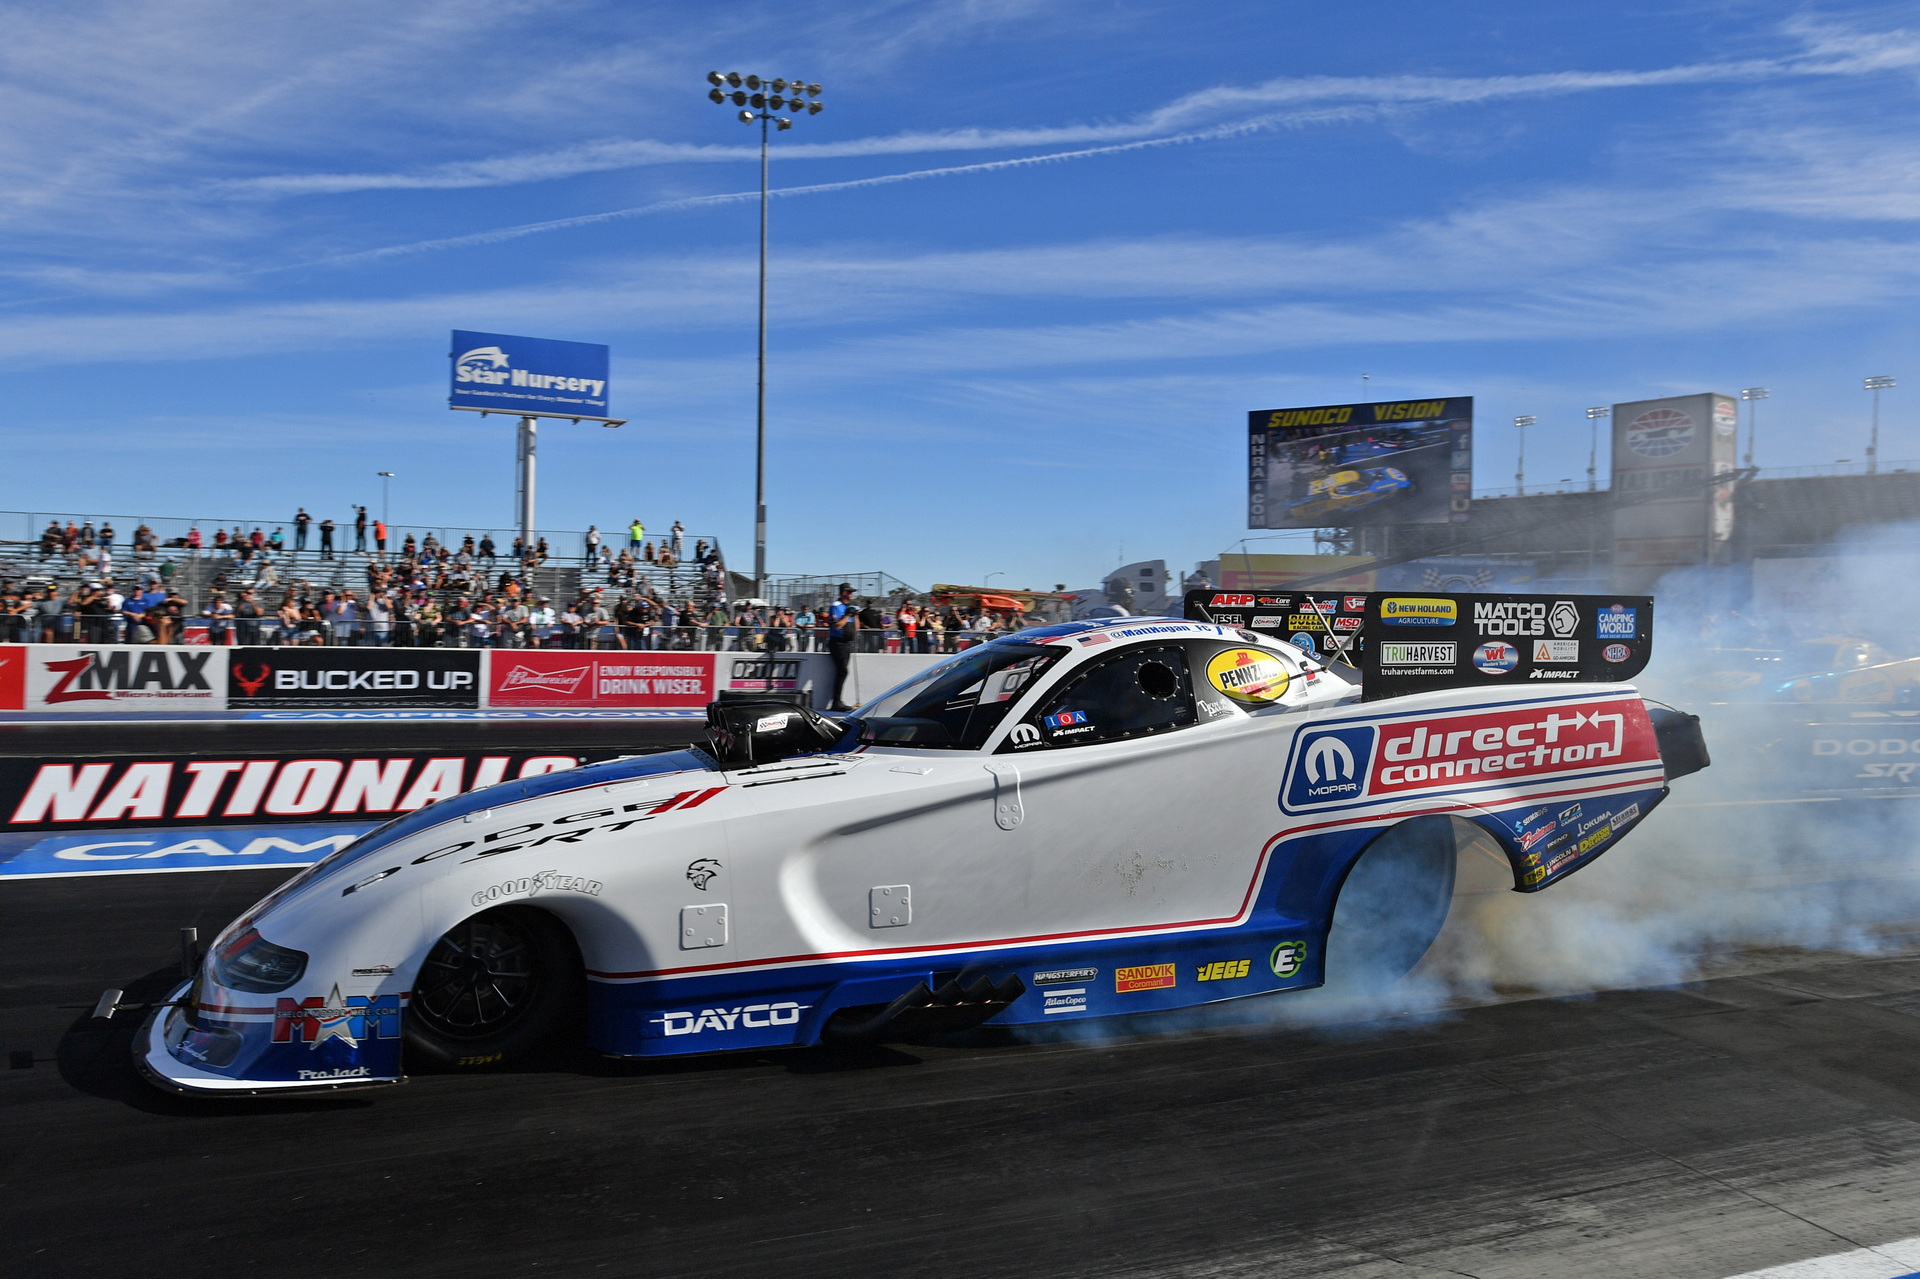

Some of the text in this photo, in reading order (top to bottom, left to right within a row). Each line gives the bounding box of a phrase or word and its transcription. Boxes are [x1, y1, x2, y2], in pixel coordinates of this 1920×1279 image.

[456, 366, 606, 396] Star Nursery
[1268, 401, 1446, 428] SUNOCO VISION
[1211, 594, 1255, 605] ARP
[1418, 605, 1452, 613] HOLLAND
[1474, 602, 1546, 619] MATCO
[1336, 618, 1360, 626] MSD
[1598, 613, 1634, 623] CAMPING
[1474, 619, 1545, 635] TOOLS
[1598, 622, 1634, 633] WORLD
[1385, 646, 1453, 661] TRUHARVEST
[1606, 647, 1626, 659] NHRA
[507, 670, 581, 686] Budweiser
[600, 666, 706, 677] ENJOY RESPONSIBLY.
[1381, 667, 1454, 676] truharvestfarms.com
[274, 670, 420, 690] BUCKED
[600, 679, 706, 695] DRINK WISER.
[1014, 742, 1042, 750] MOPAR
[1384, 713, 1562, 763] direct
[1381, 741, 1623, 785] connection
[1308, 783, 1358, 797] MOPAR
[1522, 807, 1548, 826] stratasys
[460, 816, 656, 864] SRT
[1547, 834, 1568, 849] TREND
[1546, 848, 1572, 869] LINCOLN
[1117, 965, 1173, 981] SANDVIK
[1197, 959, 1251, 982] JEGS
[1128, 979, 1164, 989] Coromant
[1044, 996, 1087, 1007] Atlas Copco
[661, 1001, 802, 1036] DAYCO
